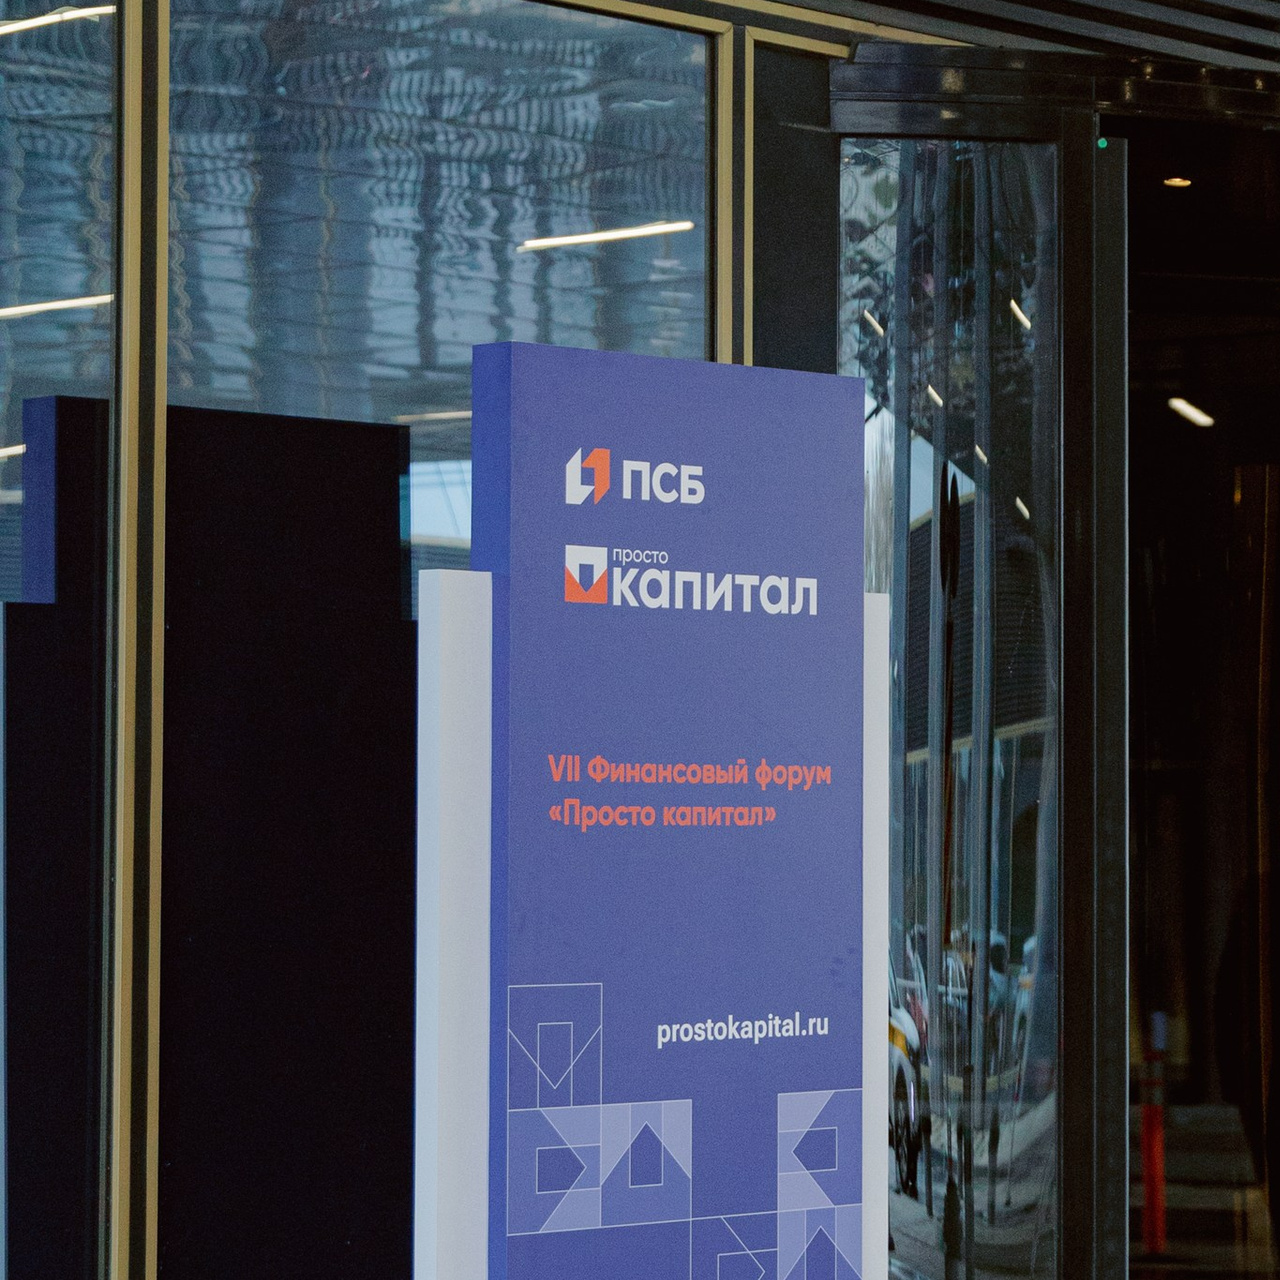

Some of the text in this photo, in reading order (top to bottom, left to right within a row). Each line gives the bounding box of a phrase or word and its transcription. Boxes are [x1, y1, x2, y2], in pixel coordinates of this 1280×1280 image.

[622, 459, 706, 505] ПСБ
[613, 548, 669, 566] просто
[612, 566, 818, 616] капитал
[548, 754, 831, 791] VII Финансовый форум
[549, 798, 777, 833] «Просто капитал»
[657, 1011, 829, 1050] prostokapital.ru
